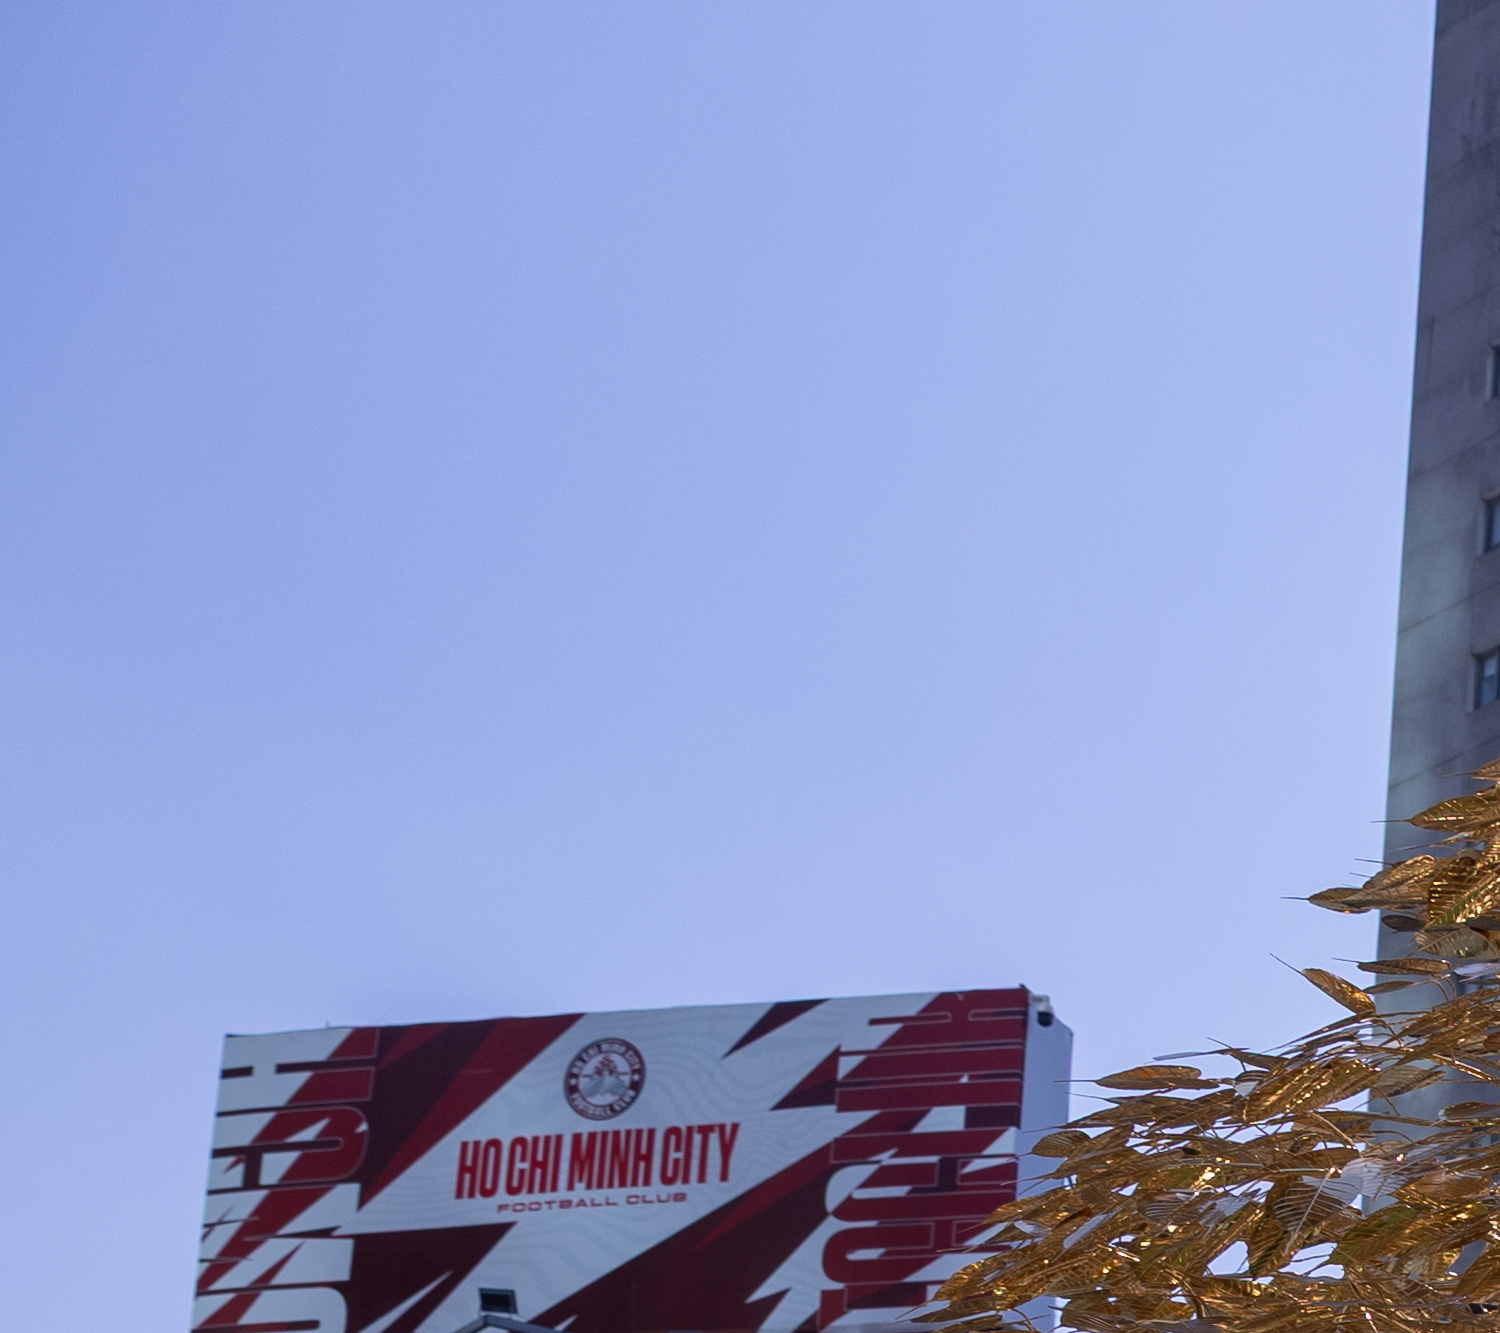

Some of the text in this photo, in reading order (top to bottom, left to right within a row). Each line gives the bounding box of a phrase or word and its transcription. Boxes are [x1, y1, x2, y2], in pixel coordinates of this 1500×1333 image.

[455, 1122, 741, 1200] HO CHI MINH CITY
[496, 1192, 688, 1214] FOOTBALL CLUB
